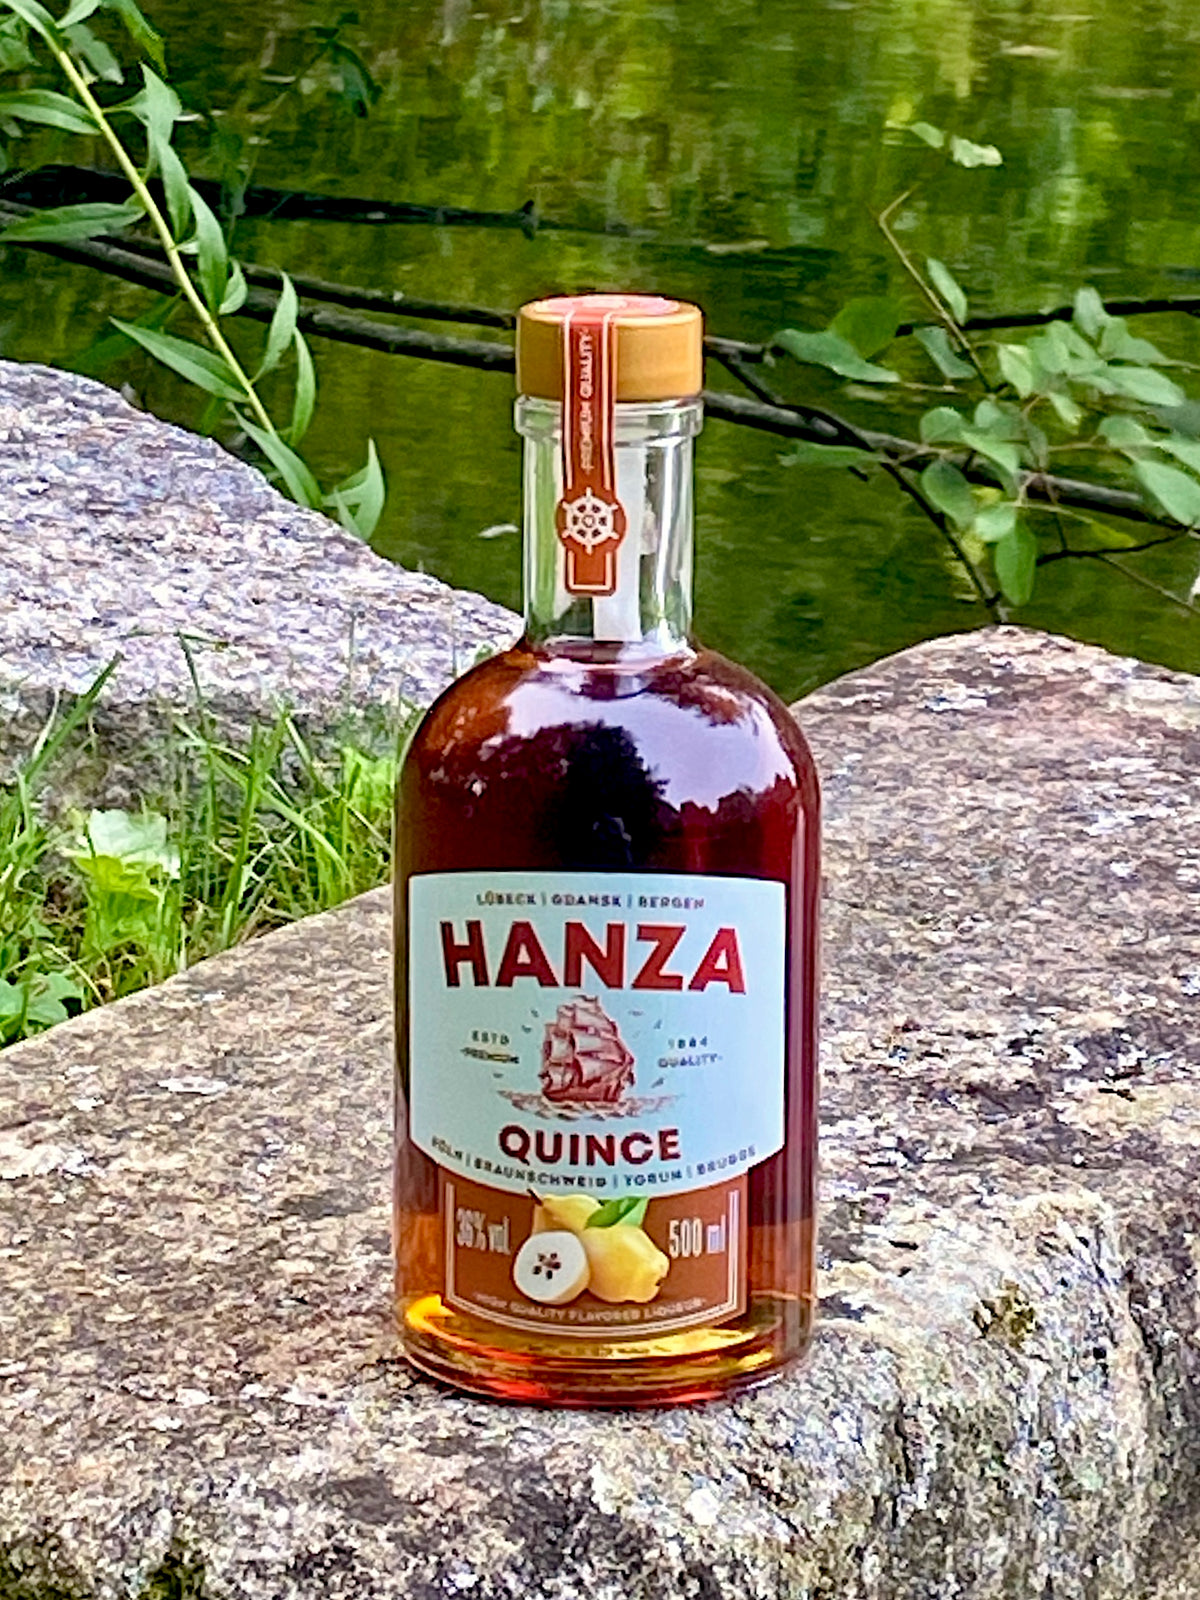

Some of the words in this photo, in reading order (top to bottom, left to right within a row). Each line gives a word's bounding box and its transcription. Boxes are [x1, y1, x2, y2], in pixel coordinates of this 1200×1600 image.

[439, 919, 747, 996] HANZA
[499, 1124, 681, 1166] QUINCE
[669, 1216, 703, 1259] 500
[706, 1214, 727, 1254] ml
